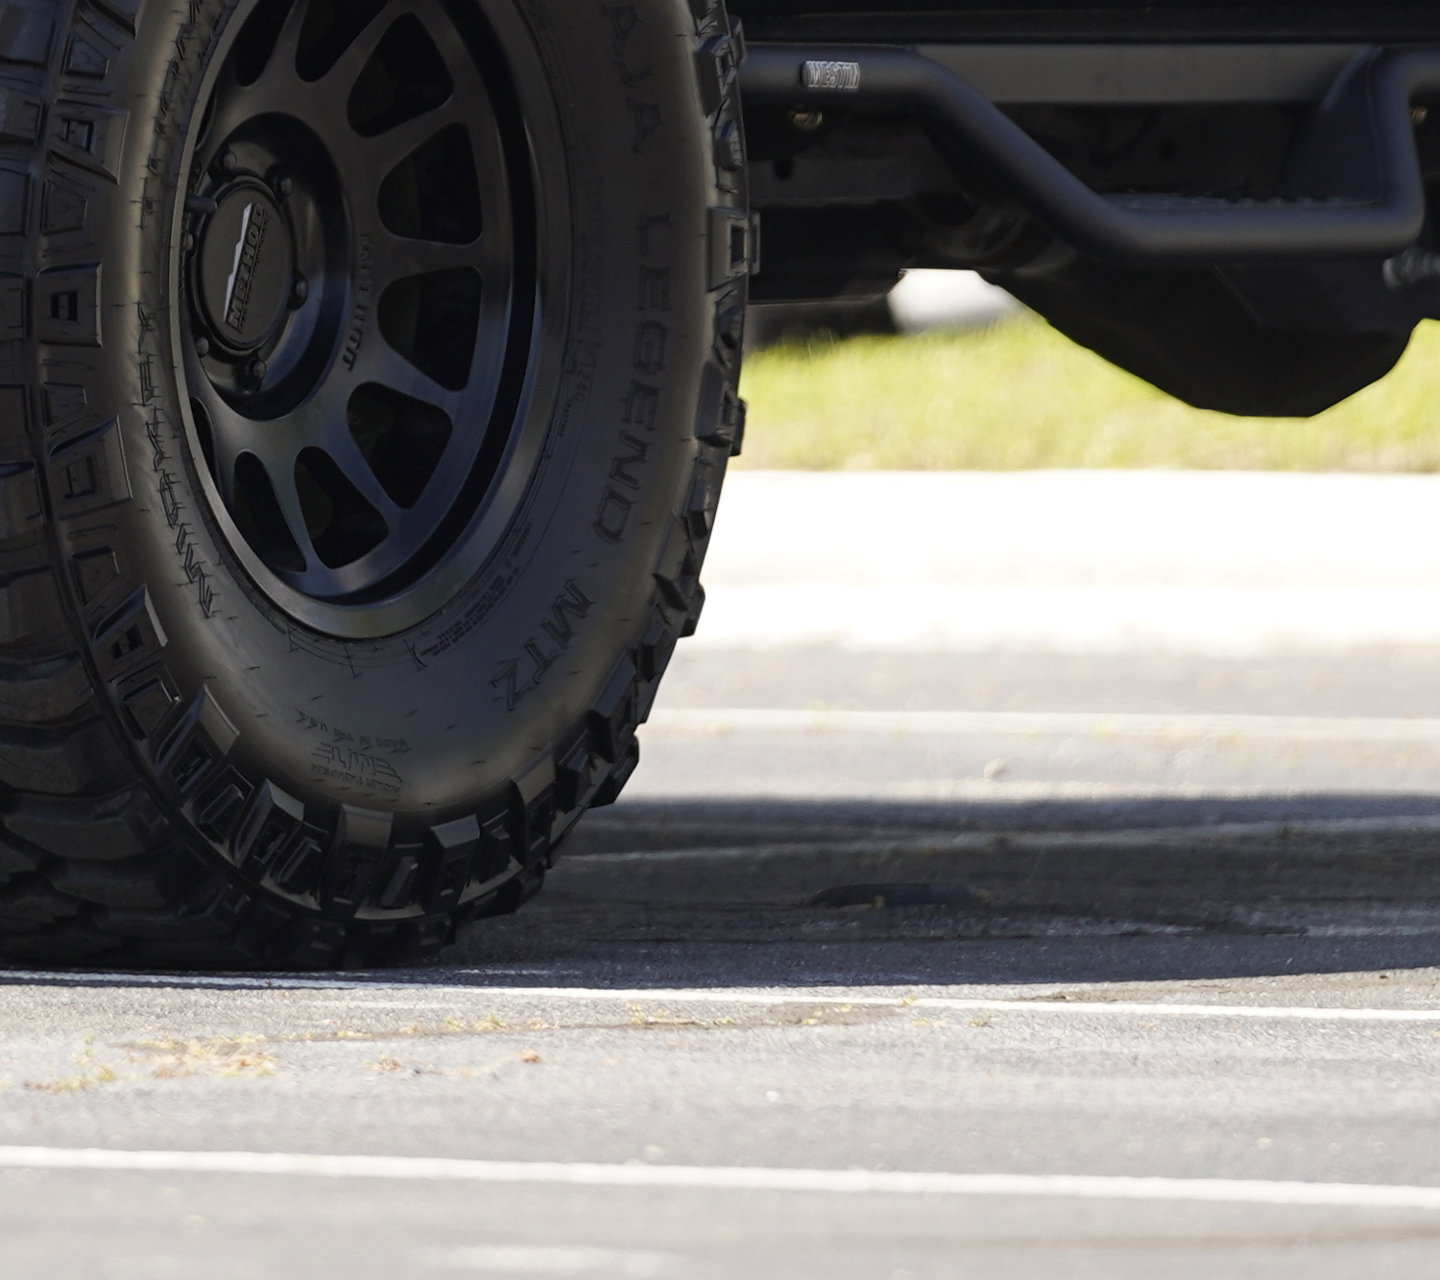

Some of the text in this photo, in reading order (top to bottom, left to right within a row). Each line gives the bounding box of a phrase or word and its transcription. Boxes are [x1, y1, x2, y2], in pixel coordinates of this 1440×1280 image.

[805, 60, 861, 89] WESTIN
[227, 202, 267, 331] METHOD
[592, 210, 674, 544] LEGEND
[488, 579, 594, 712] MTZ
